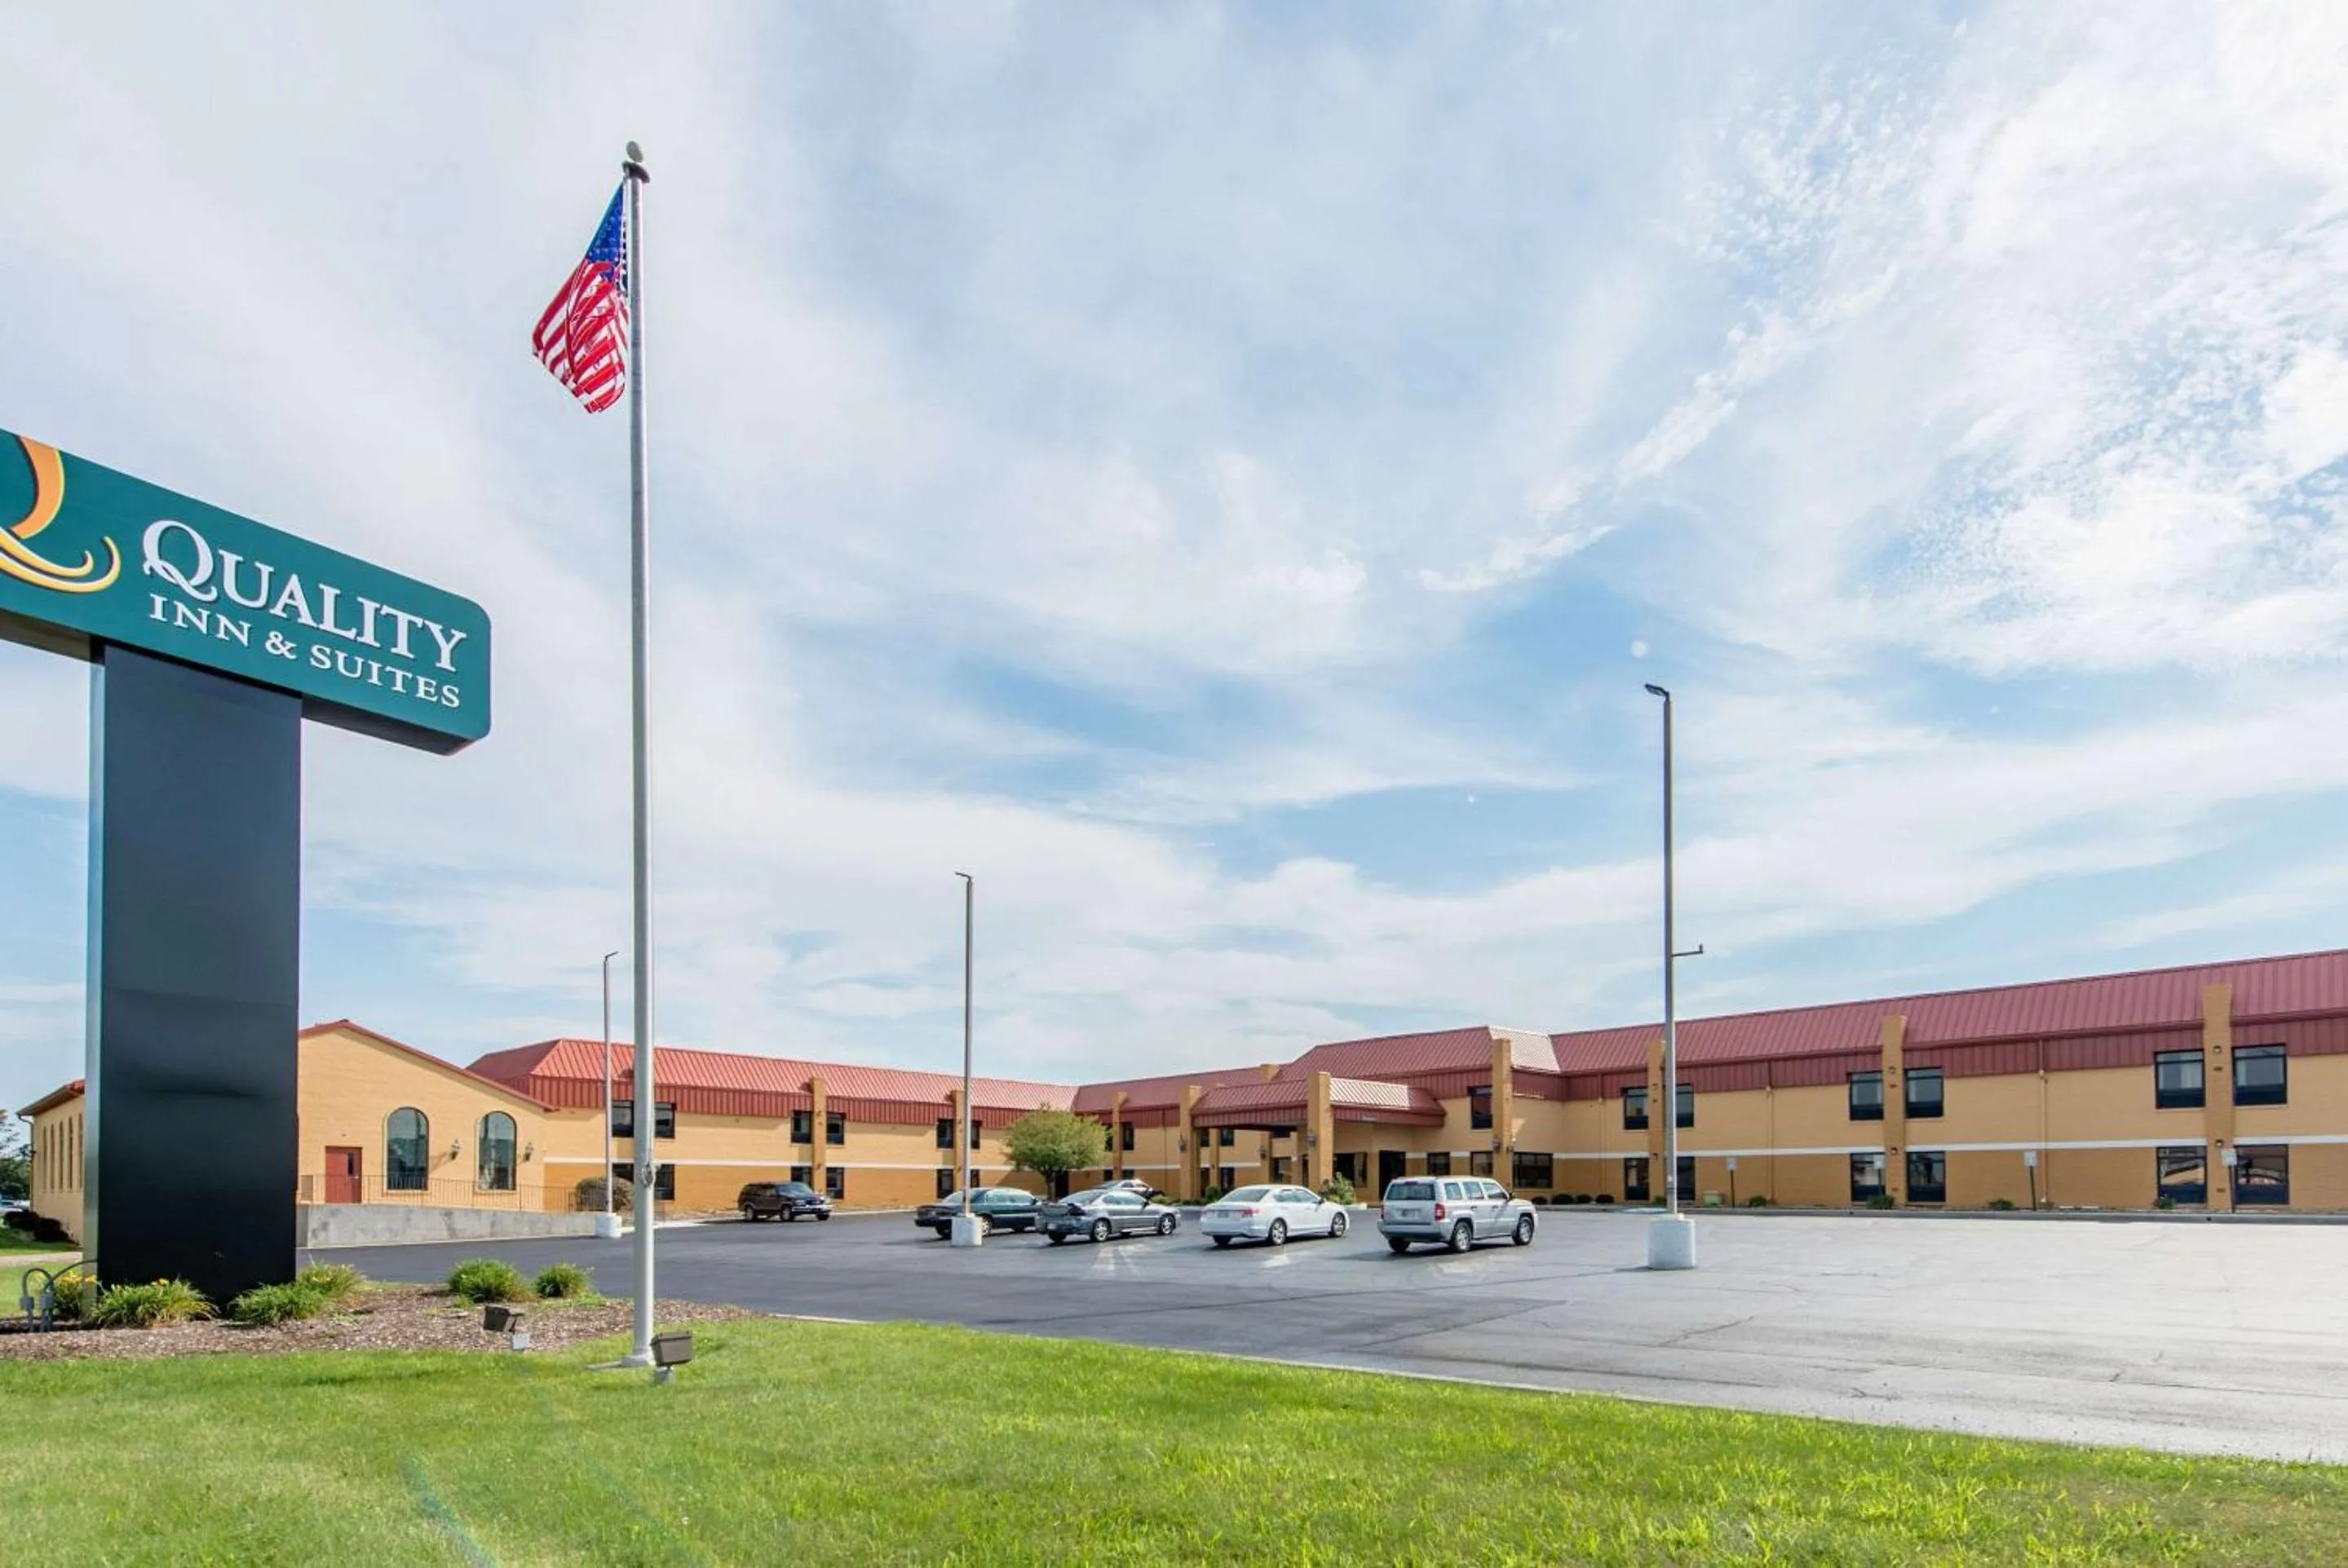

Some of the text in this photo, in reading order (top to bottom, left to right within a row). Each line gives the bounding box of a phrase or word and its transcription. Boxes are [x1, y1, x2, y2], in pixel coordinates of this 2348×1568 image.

[142, 519, 467, 672] QUALITY
[149, 594, 460, 708] INN & SUITES
